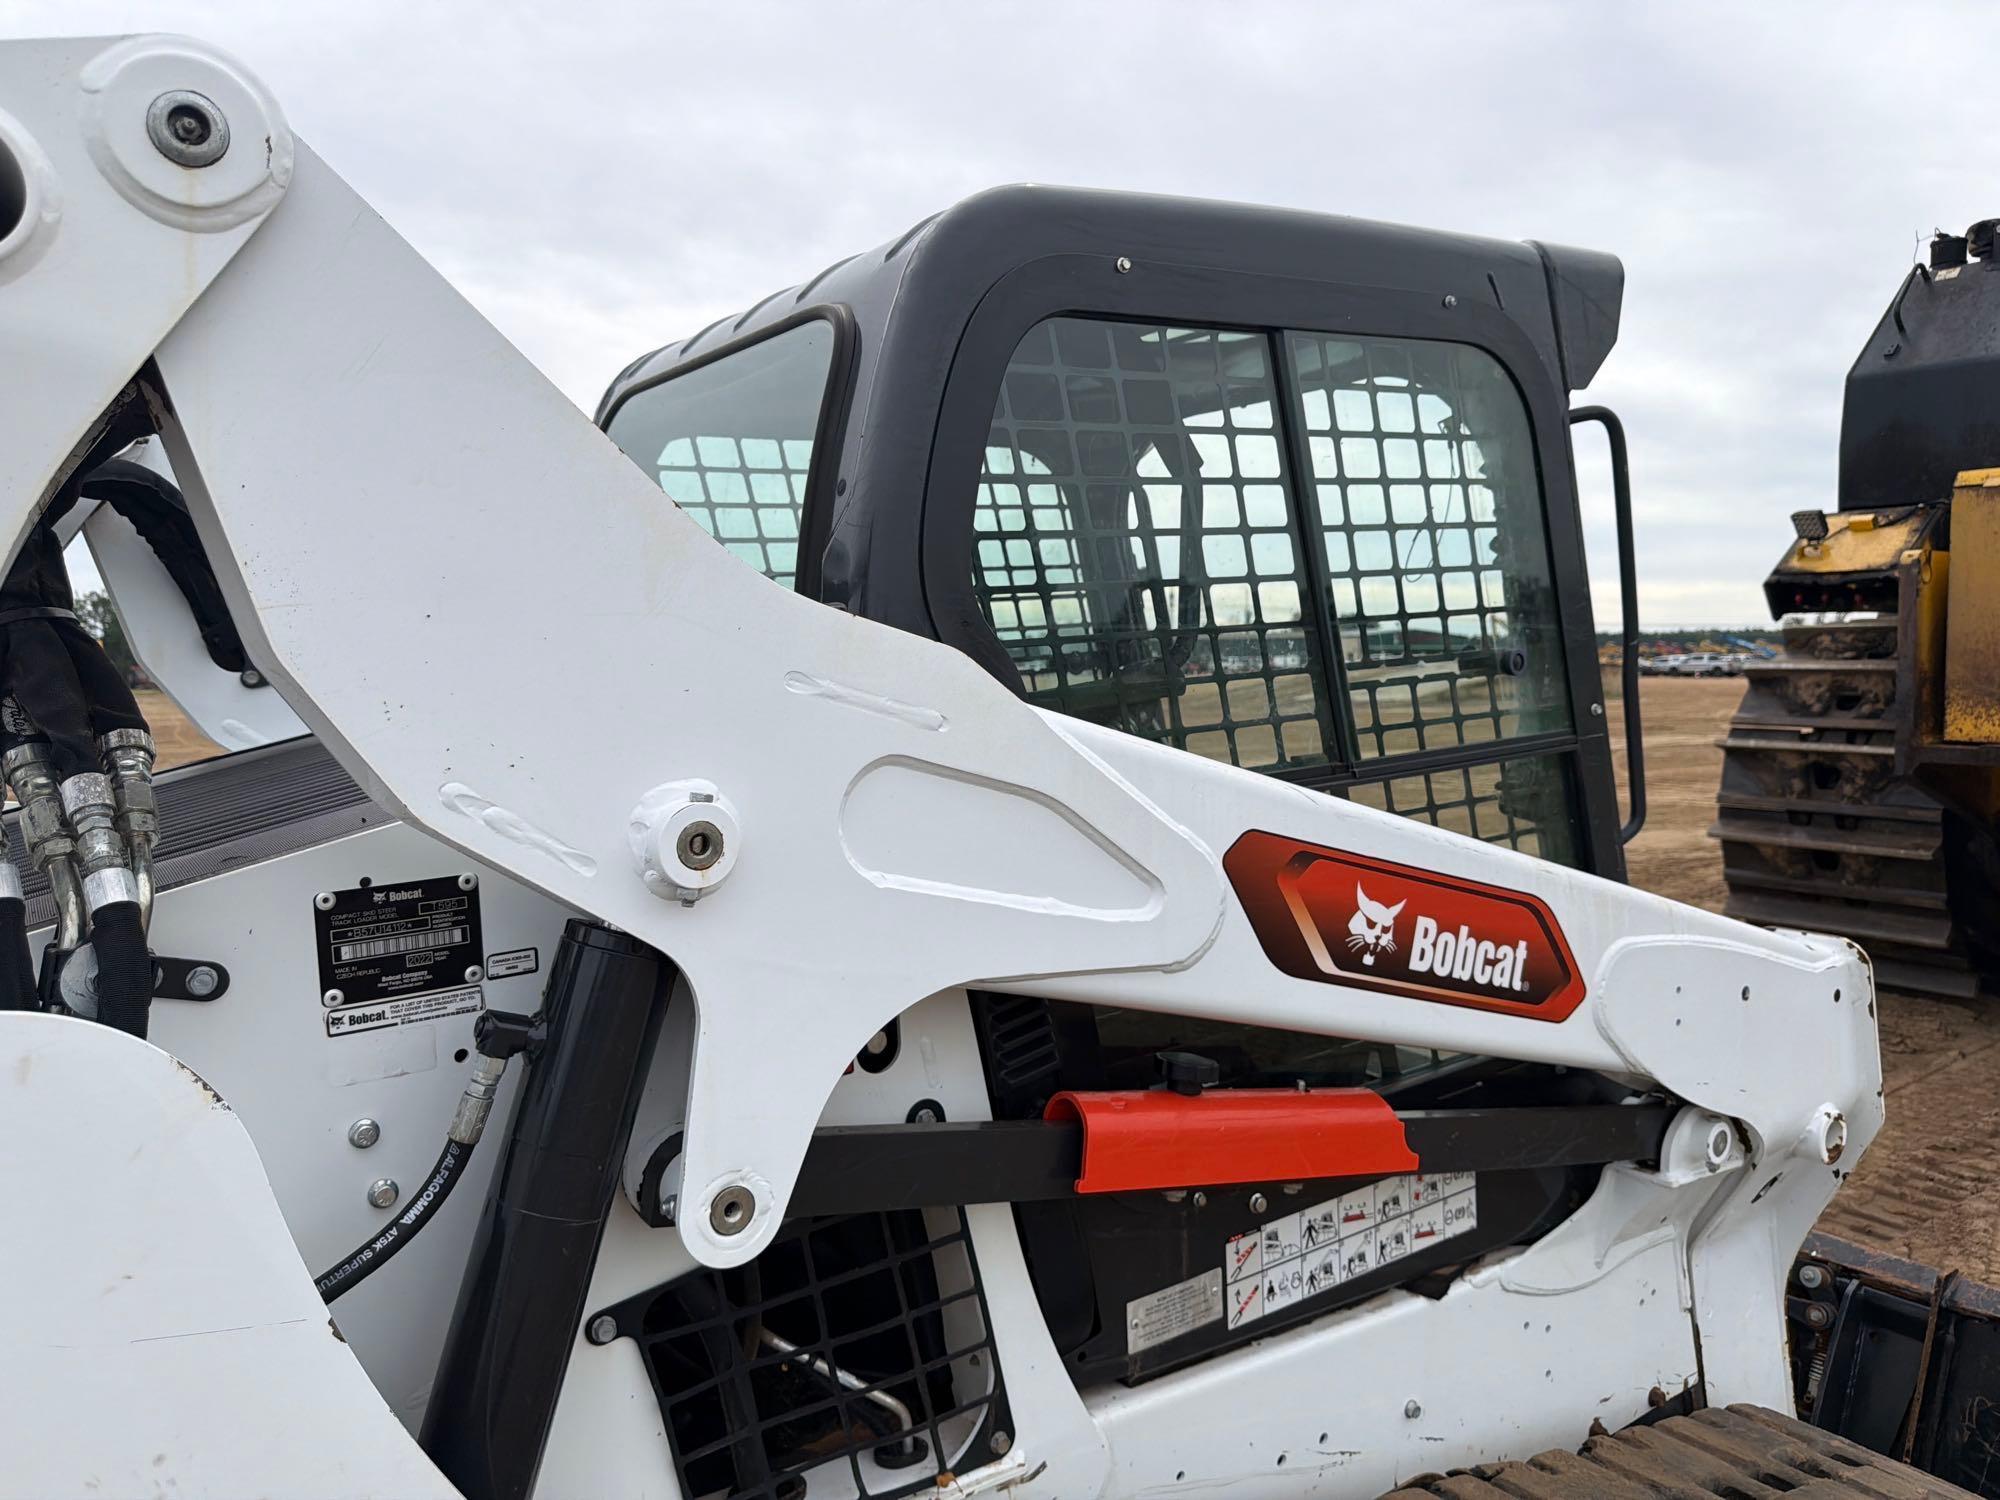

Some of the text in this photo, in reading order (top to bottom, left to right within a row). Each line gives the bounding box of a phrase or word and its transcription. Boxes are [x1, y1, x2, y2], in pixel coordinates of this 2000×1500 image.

[389, 888, 423, 902] Bobcat
[432, 900, 458, 910] T595
[330, 907, 397, 921] COMPACT SKID STEER
[330, 912, 398, 927] TRACK LOADER MODEL
[408, 953, 431, 966] 2022
[1408, 914, 1528, 992] Bobcat
[334, 966, 350, 974] MADE
[336, 967, 381, 980] CZECH REPUBLIC
[381, 970, 428, 983] Bobcat Company
[441, 993, 459, 1001] STATES
[459, 989, 480, 998] PATENTS
[404, 1005, 422, 1013] COVER
[348, 1009, 386, 1027] Bobcat
[399, 1155, 455, 1225] ALFAGOMMA
